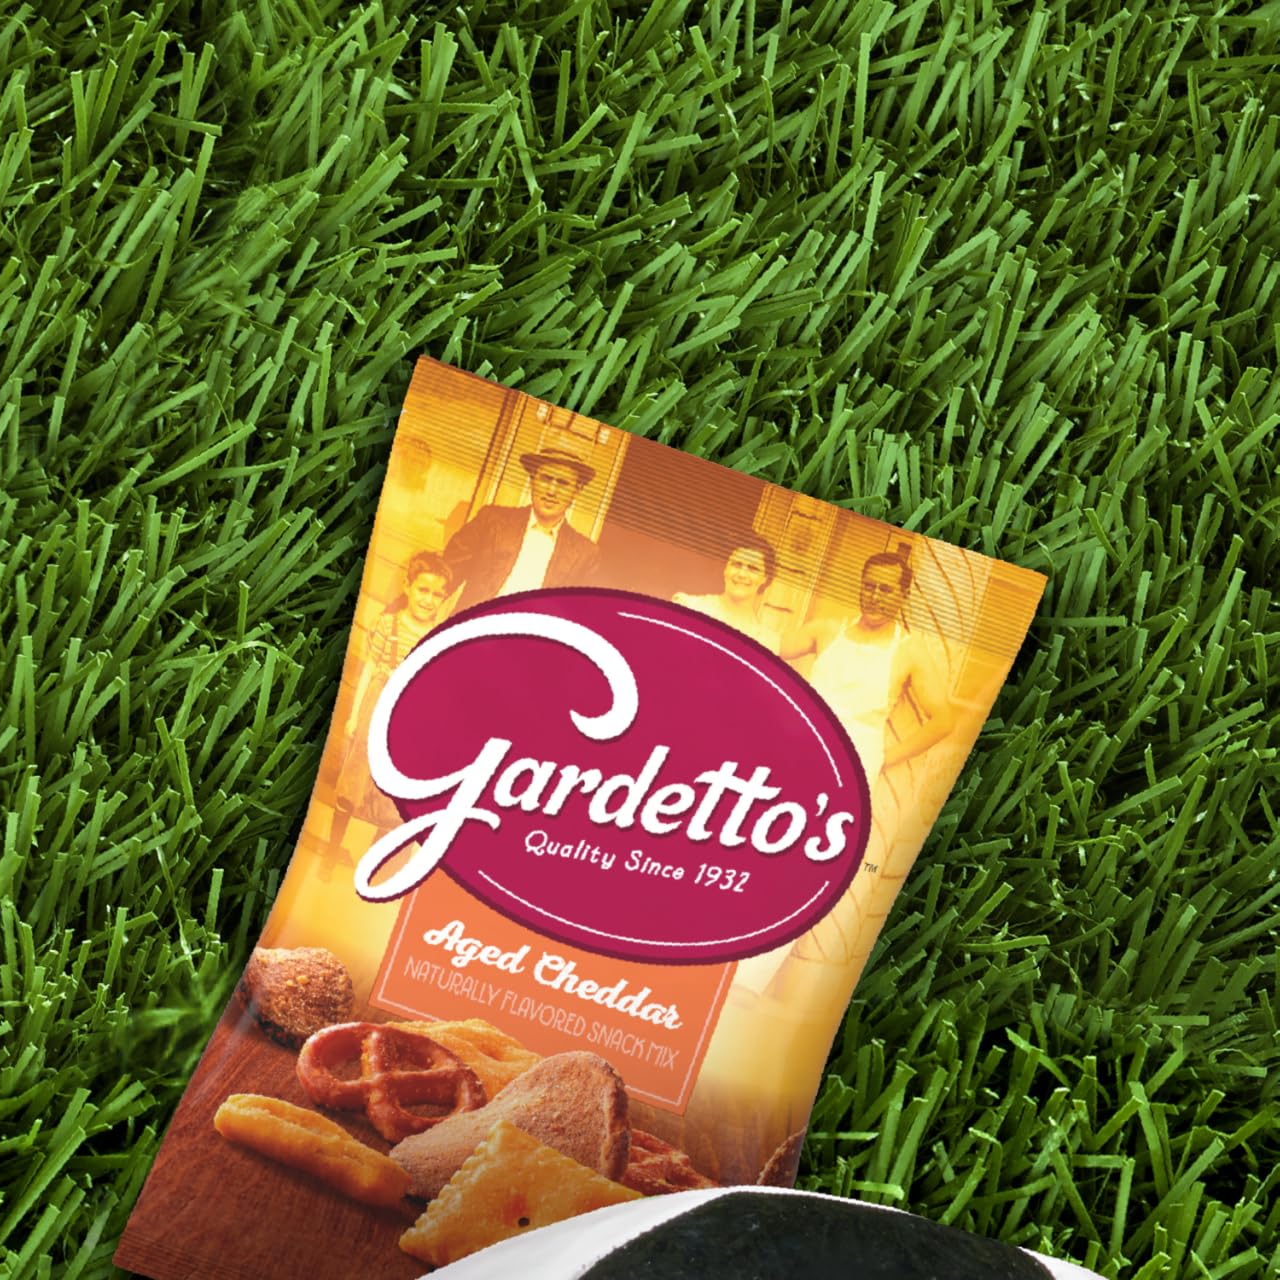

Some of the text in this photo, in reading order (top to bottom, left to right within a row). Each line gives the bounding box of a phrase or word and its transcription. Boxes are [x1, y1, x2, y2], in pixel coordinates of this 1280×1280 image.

[353, 611, 856, 902] Gardetto's
[524, 829, 751, 894] Quality Since 1932
[402, 956, 681, 1072] NATURALLY FLAVORED SNACK MIX
[423, 919, 684, 1030] Aged Cheddar
